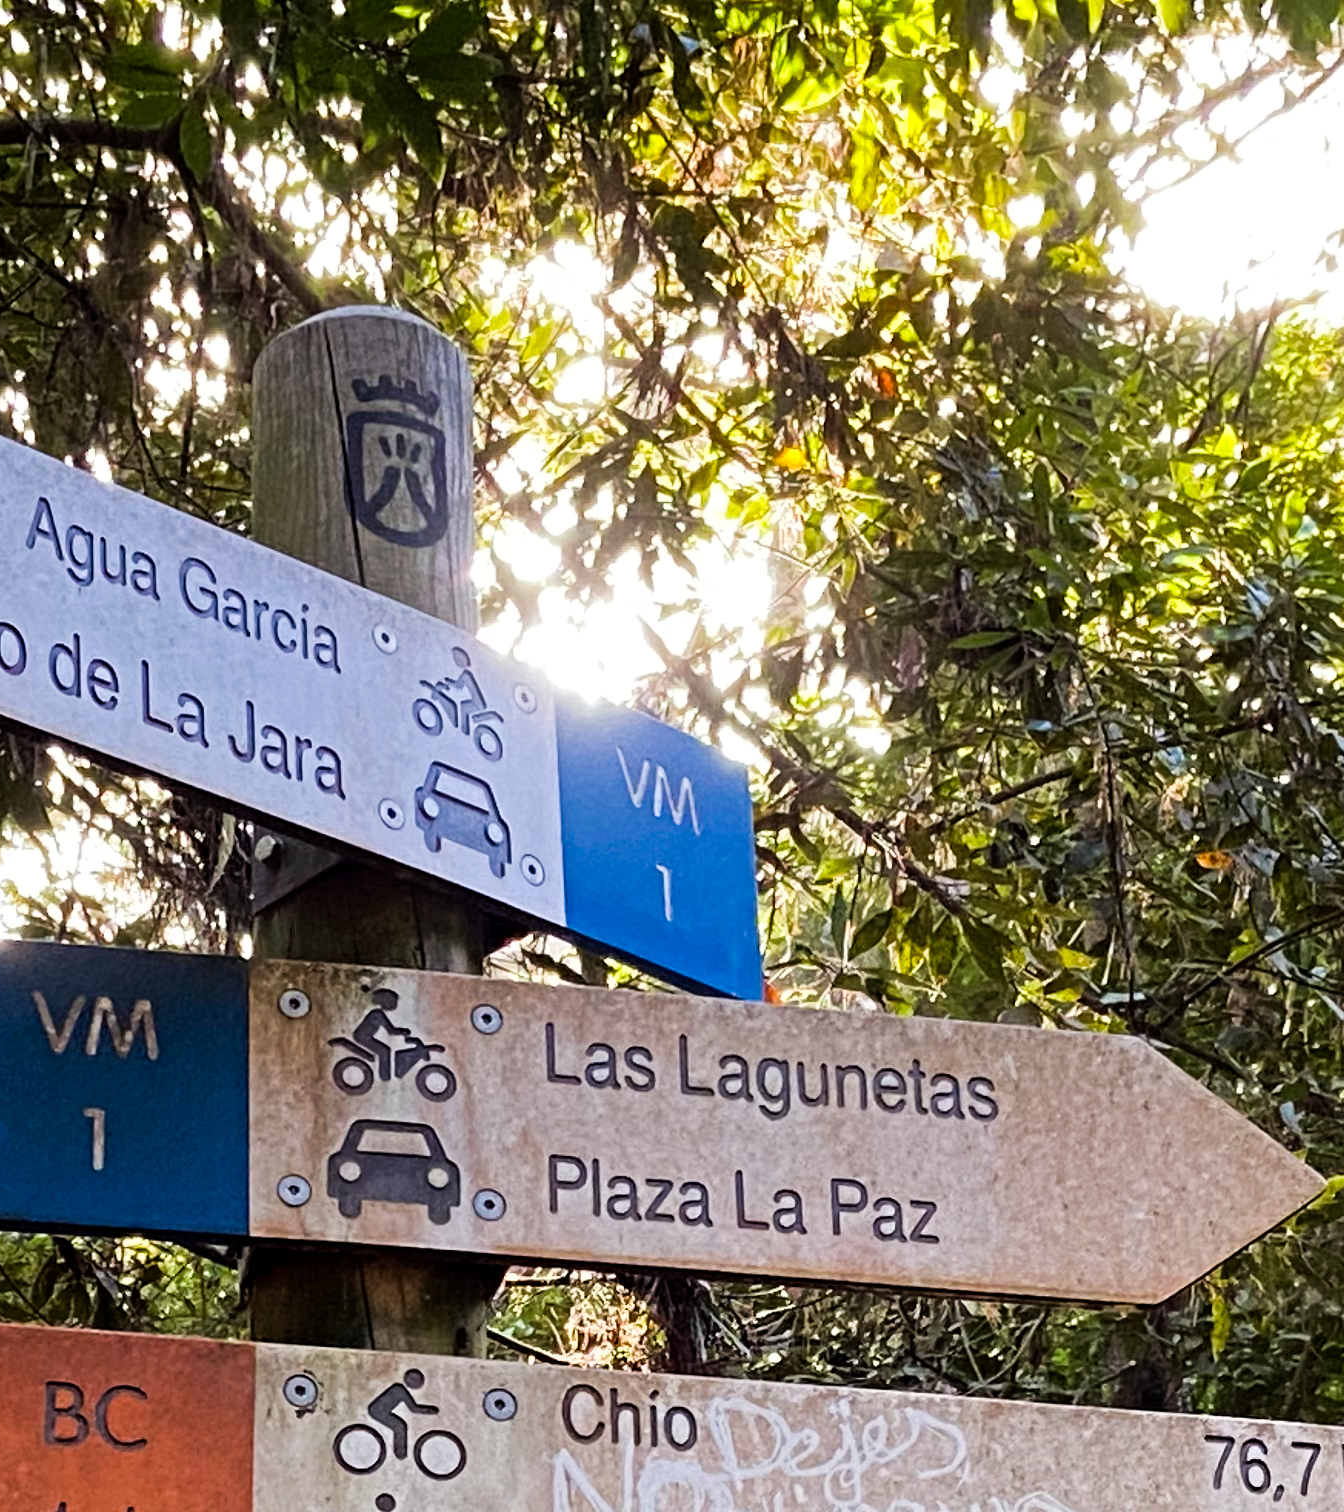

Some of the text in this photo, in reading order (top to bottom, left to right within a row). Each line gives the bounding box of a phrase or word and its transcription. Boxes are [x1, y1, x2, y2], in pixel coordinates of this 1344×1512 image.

[25, 496, 161, 602] Agua
[48, 633, 120, 712] de
[141, 659, 210, 749] La
[227, 699, 347, 801] Jara
[615, 745, 702, 836] VM
[655, 863, 674, 922] 1
[31, 989, 160, 1062] VM
[545, 1022, 1000, 1122] Las Lagunetas
[82, 1107, 106, 1172] 1
[548, 1153, 941, 1245] Plaza La Paz
[43, 1379, 149, 1453] BC
[1203, 1433, 1323, 1503] 76,7
